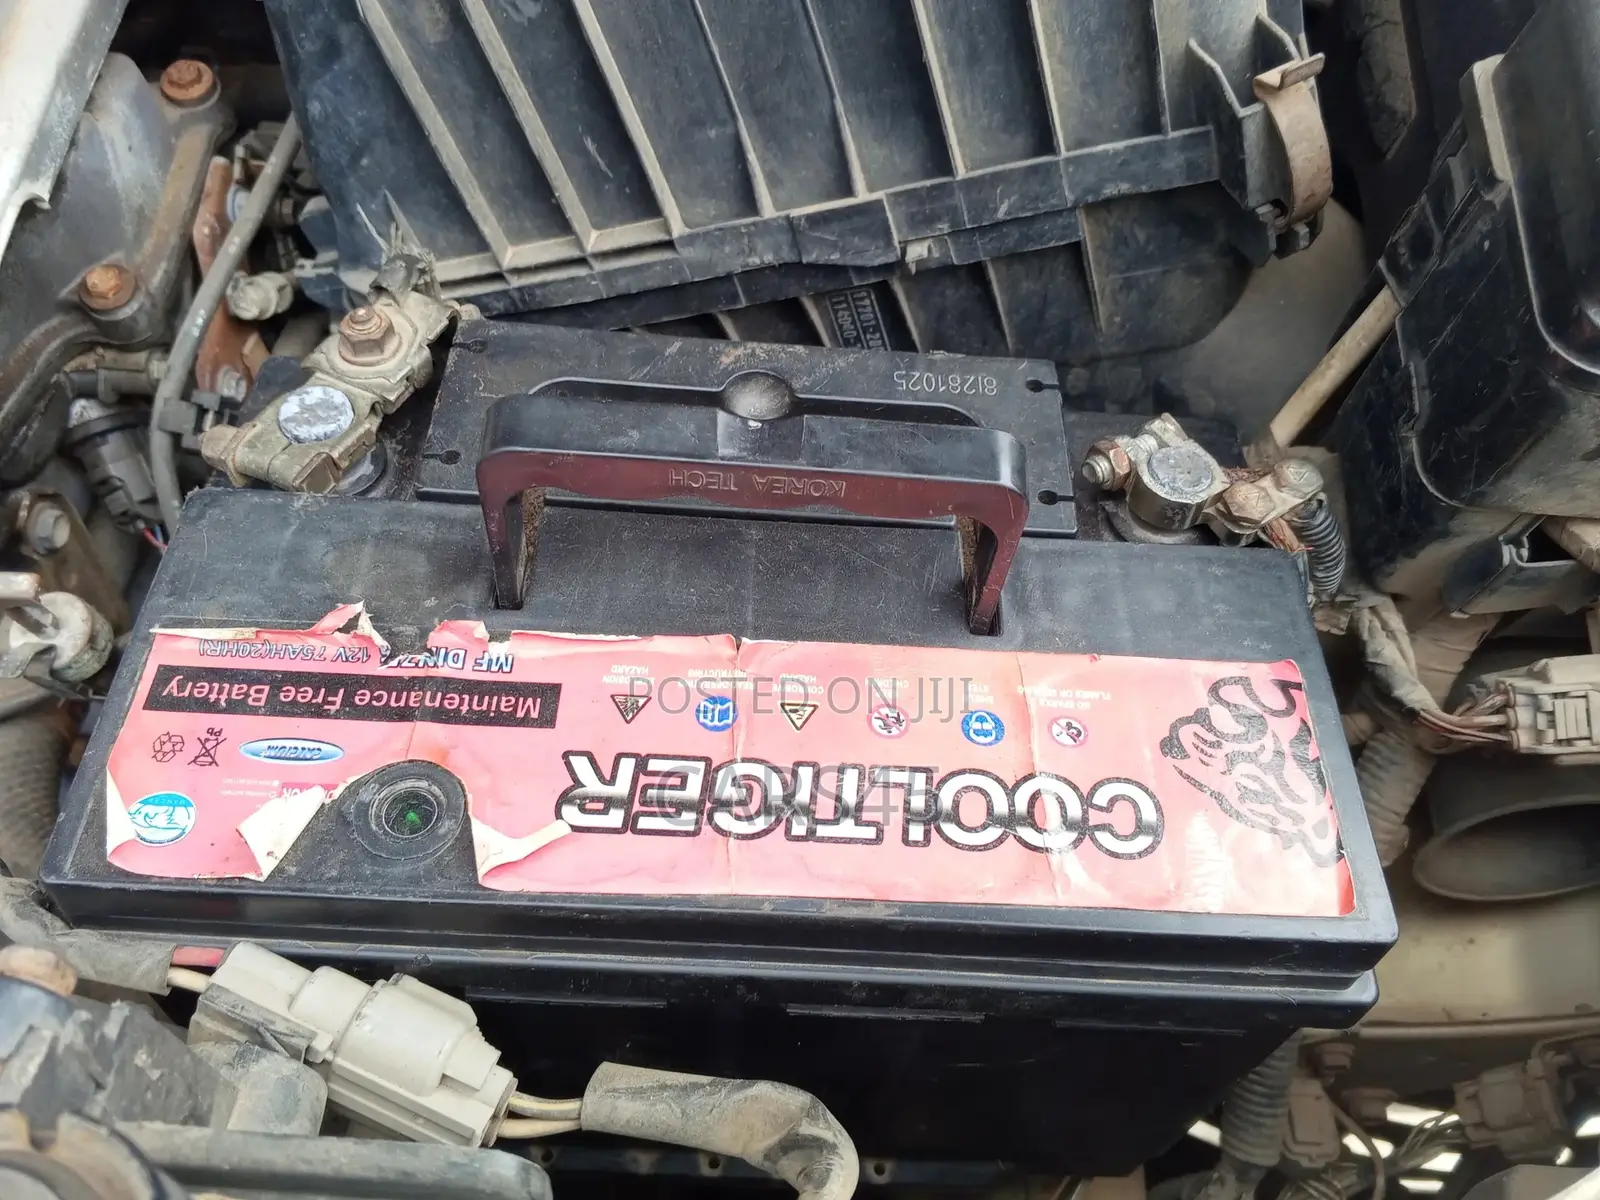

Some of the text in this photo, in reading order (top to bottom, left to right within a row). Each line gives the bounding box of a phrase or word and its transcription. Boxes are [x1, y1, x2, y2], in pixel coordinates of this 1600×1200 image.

[668, 468, 847, 498] KOREA TECH
[199, 637, 327, 662] 75AH(20HR)
[331, 646, 372, 664] 12V
[472, 650, 515, 673] MF
[162, 675, 541, 719] Maintenance Free Battery
[206, 726, 224, 737] Pb
[555, 750, 1166, 861] COOLTIGER
